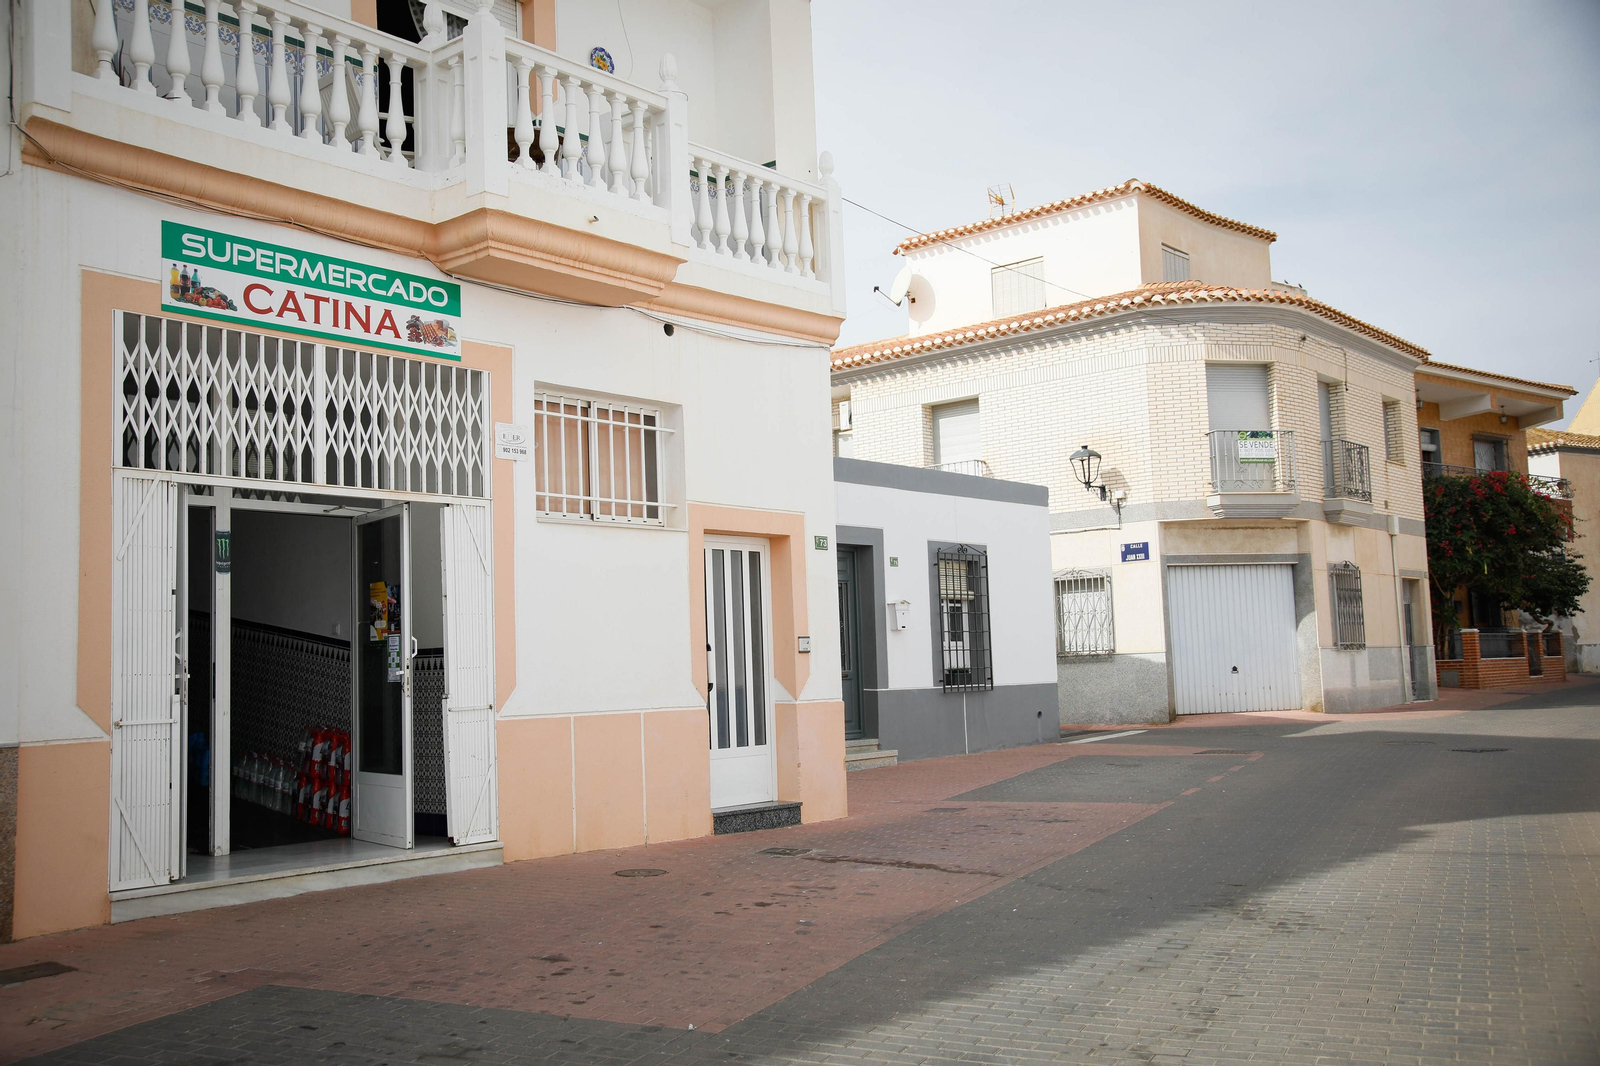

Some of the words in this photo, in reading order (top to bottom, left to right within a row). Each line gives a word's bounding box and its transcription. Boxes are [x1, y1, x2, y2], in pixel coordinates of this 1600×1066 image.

[181, 232, 449, 308] SUPERMERCADO
[242, 283, 403, 340] CATINA
[819, 539, 828, 547] 73
